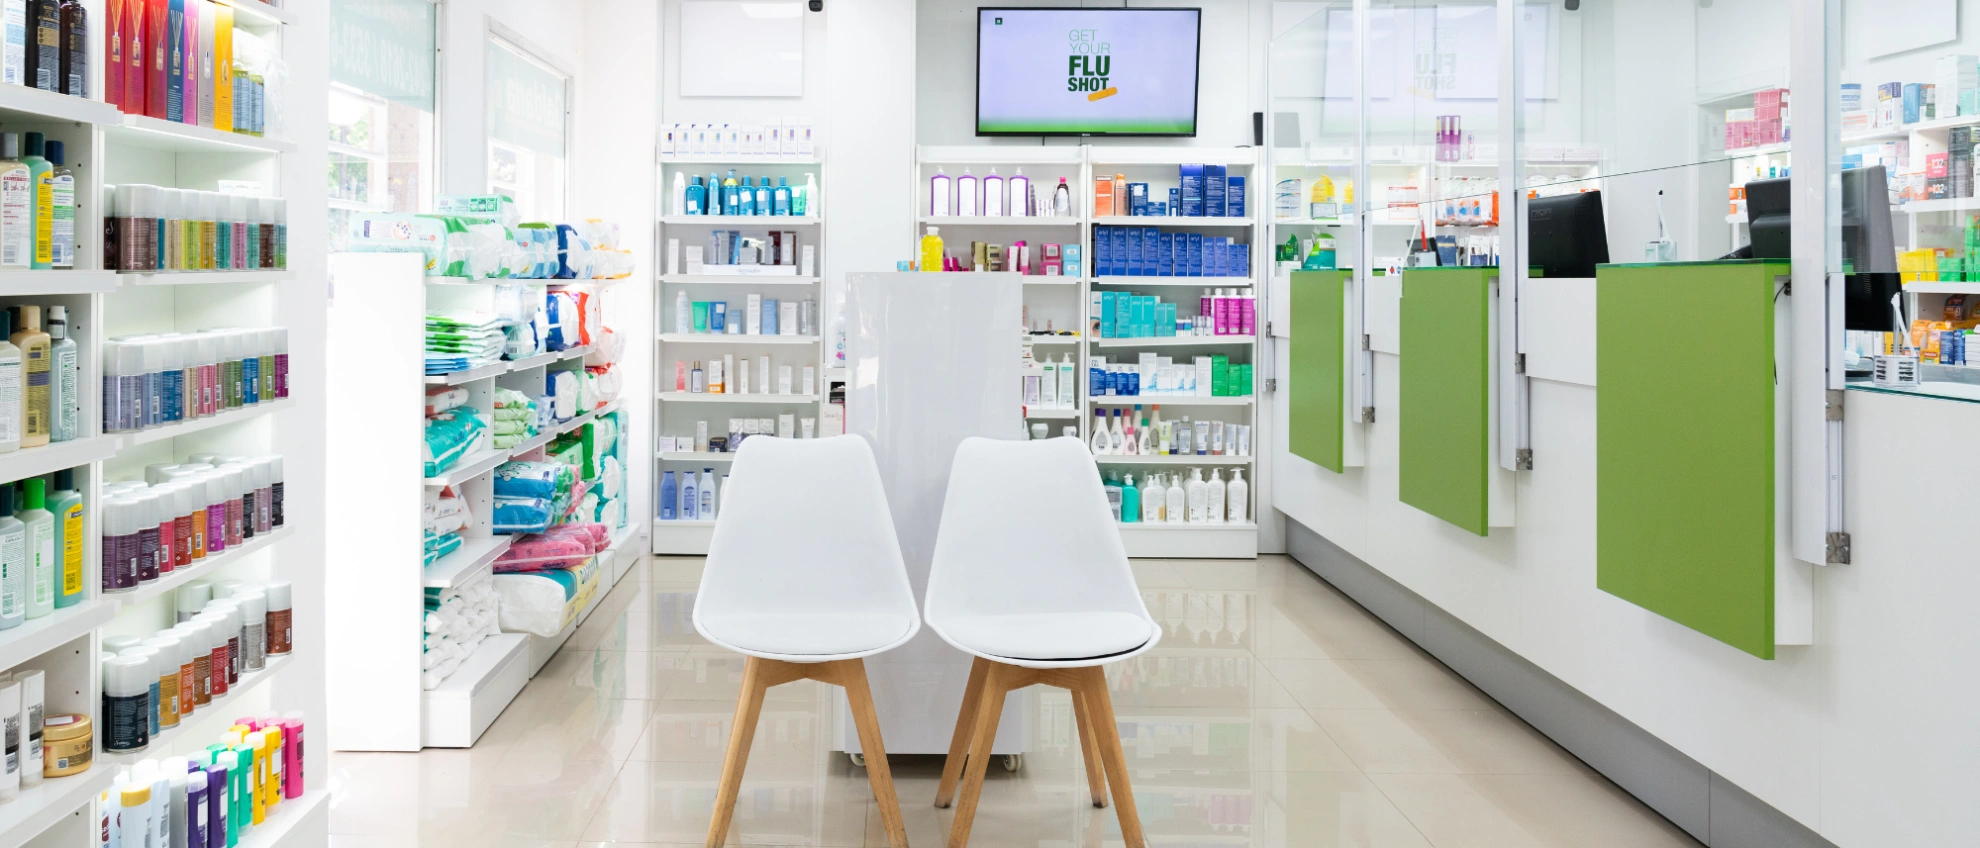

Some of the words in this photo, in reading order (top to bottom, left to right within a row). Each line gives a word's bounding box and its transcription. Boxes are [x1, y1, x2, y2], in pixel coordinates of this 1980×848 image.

[1069, 30, 1098, 42] GET
[1069, 42, 1111, 54] YOUR
[1069, 56, 1111, 76] FLU
[1068, 77, 1110, 92] SHOT
